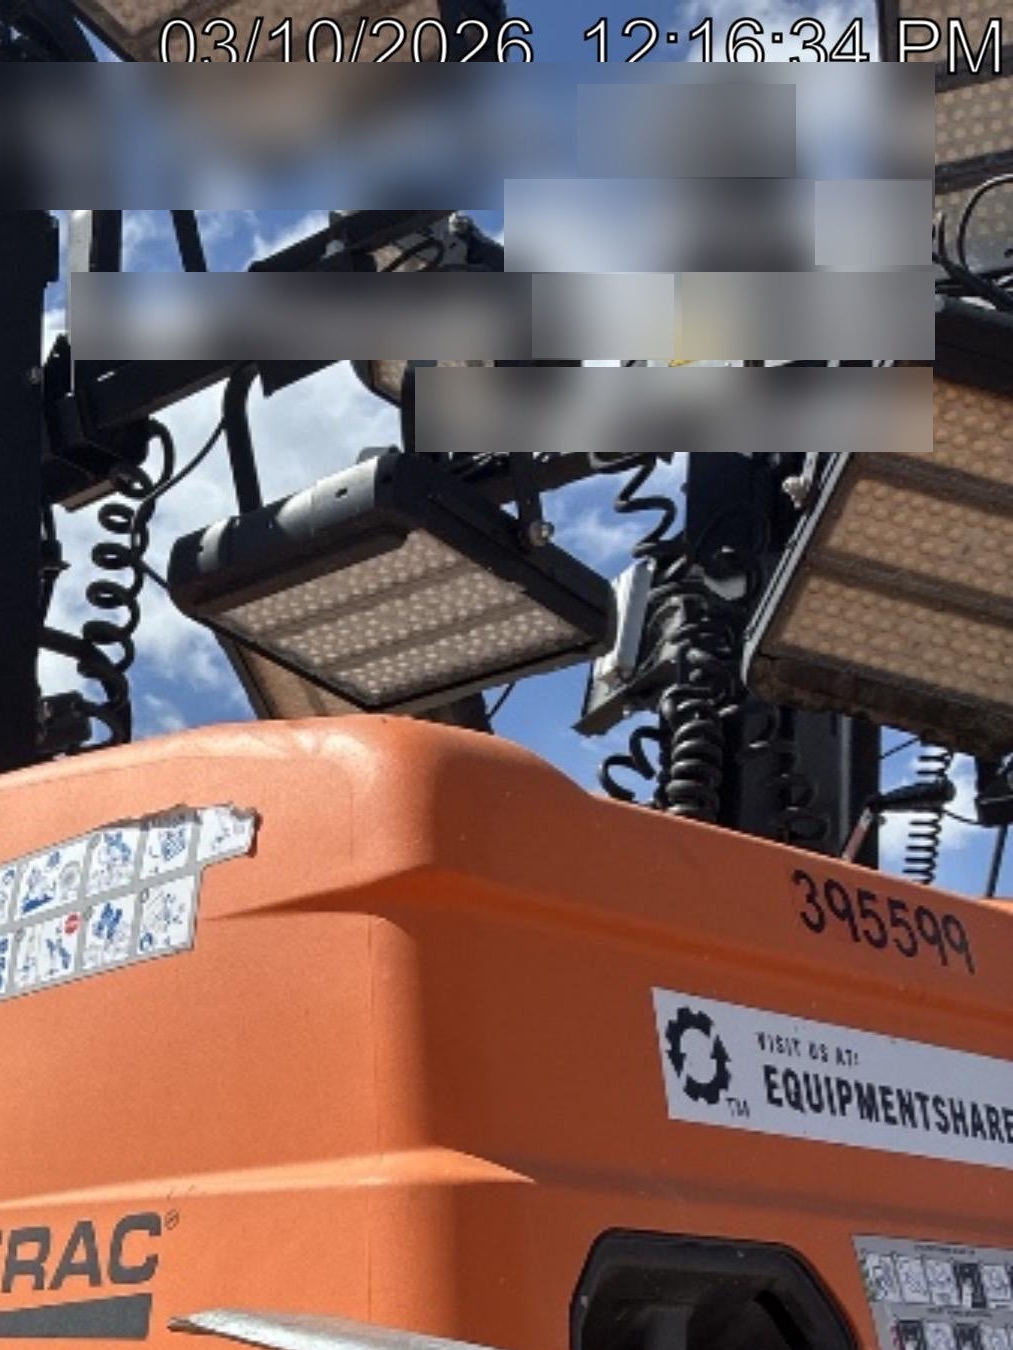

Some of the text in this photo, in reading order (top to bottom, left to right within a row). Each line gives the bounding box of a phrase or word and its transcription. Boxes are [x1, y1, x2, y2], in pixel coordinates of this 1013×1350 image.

[792, 868, 975, 976] 395599
[756, 1031, 801, 1057] VISIT
[809, 1042, 828, 1063] US
[763, 1064, 1013, 1144] EQUIPMENTSHARE
